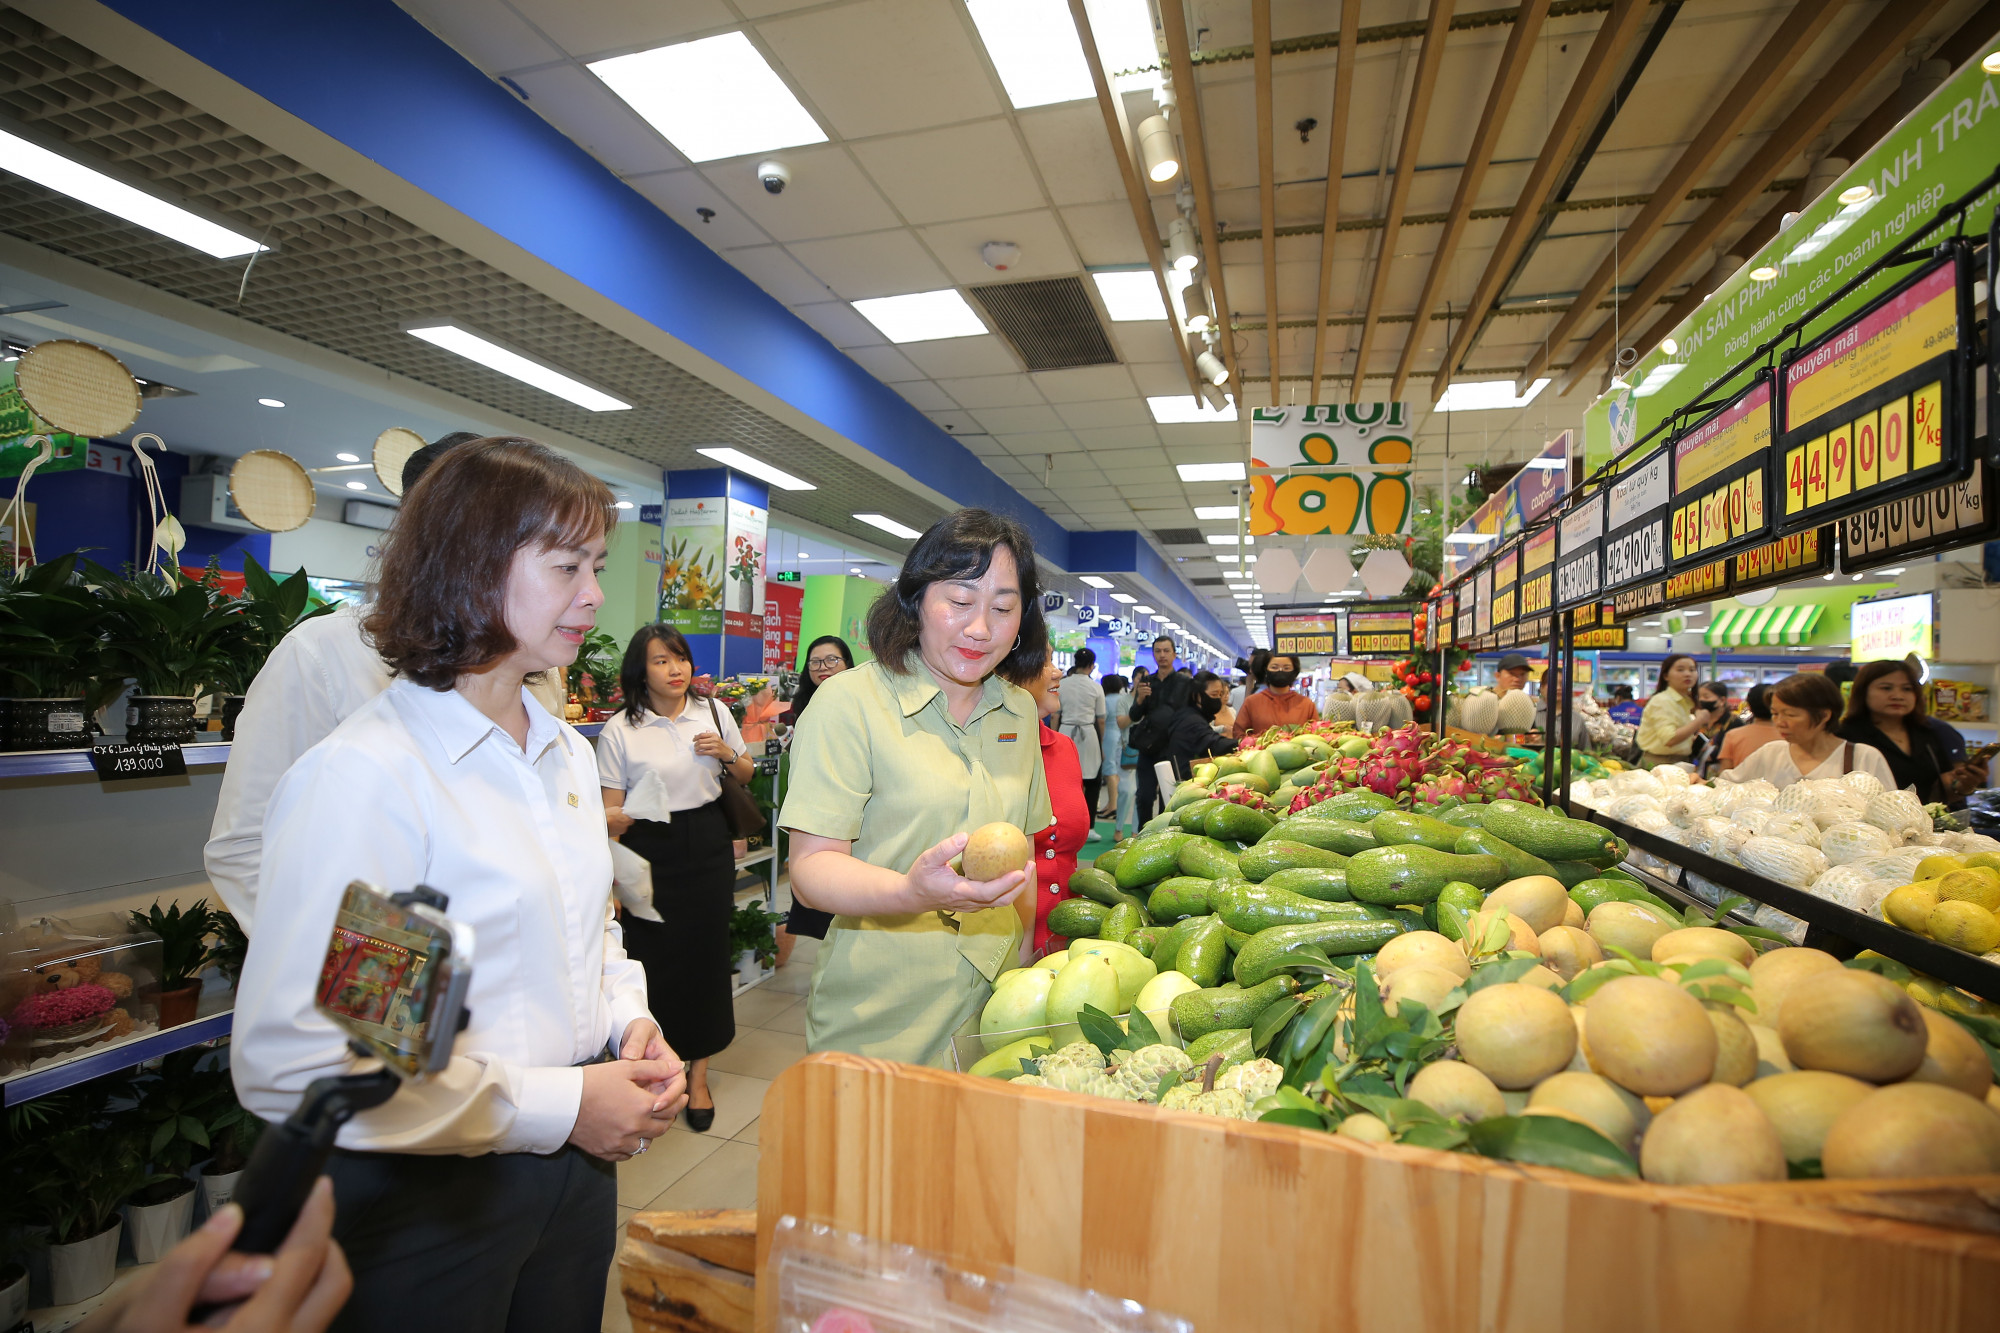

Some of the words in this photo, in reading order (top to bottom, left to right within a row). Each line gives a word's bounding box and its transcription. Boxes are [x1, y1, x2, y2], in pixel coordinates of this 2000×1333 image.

[1669, 327, 1703, 365] HỌN
[1866, 137, 1922, 198] ANH
[1724, 331, 1749, 358] Đồng
[1750, 308, 1776, 339] hành
[1777, 287, 1806, 320] cùng
[1808, 268, 1831, 294] các
[1834, 229, 1881, 275] Doanh
[1884, 182, 1945, 238] nghiệp
[1788, 344, 1831, 385] Khuyến
[1834, 326, 1858, 355] mãi
[1677, 429, 1704, 456] Khuyến
[1705, 417, 1719, 438] mãi
[1790, 412, 1902, 497] 44.900
[1650, 466, 1658, 480] kg
[1608, 531, 1650, 576] 42.900
[1046, 596, 1061, 607] 01
[1079, 610, 1093, 620] 02
[1109, 622, 1122, 631] 03
[1137, 632, 1148, 641] 05
[1354, 636, 1398, 648] 41.900
[1279, 639, 1323, 650] 49.000
[114, 757, 164, 772] 139.000
